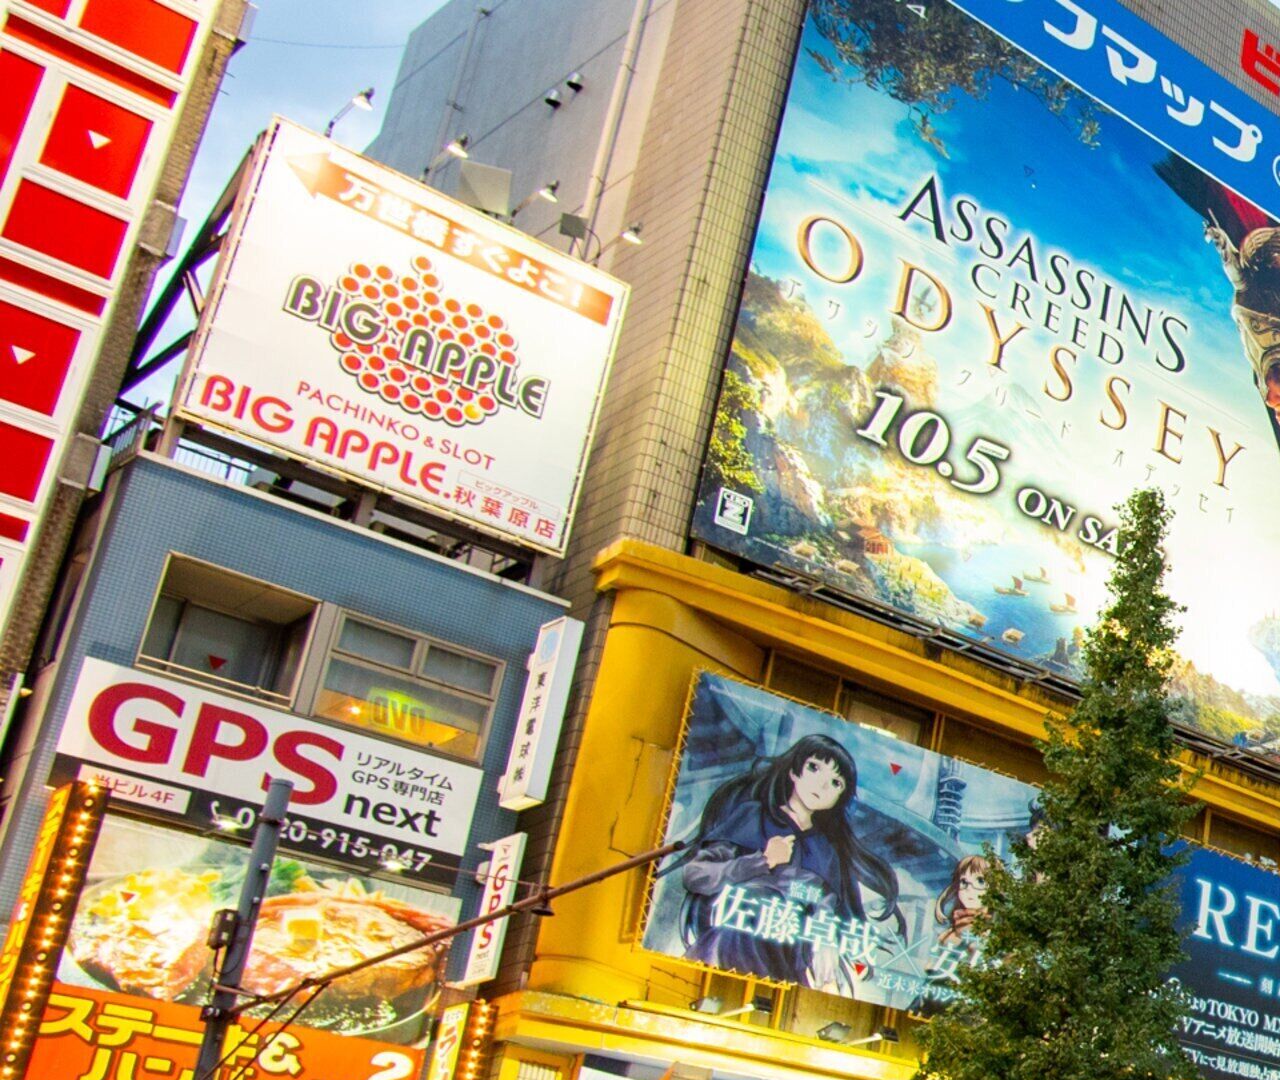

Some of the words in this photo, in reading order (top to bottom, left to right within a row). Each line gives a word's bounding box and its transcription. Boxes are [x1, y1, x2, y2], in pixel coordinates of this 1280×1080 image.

[1005, 0, 1263, 162] フマップ
[899, 175, 1189, 374] ASSASSIN'S
[970, 263, 1126, 367] CREED
[284, 273, 383, 342] BIG
[402, 328, 548, 417] APPLE
[795, 213, 1247, 491] ODYSSEY
[199, 374, 295, 435] BIG
[298, 380, 420, 443] PACHINKO
[440, 439, 496, 471] SLOT
[856, 389, 1011, 495] 10.5
[1016, 486, 1078, 533] ON
[453, 486, 556, 540] 秋葉原店
[86, 680, 346, 807] GPS
[356, 751, 454, 792] リアルタイム
[235, 805, 433, 874] 020-915-047
[343, 791, 442, 839] next
[709, 883, 881, 967] 佐藤卓哉
